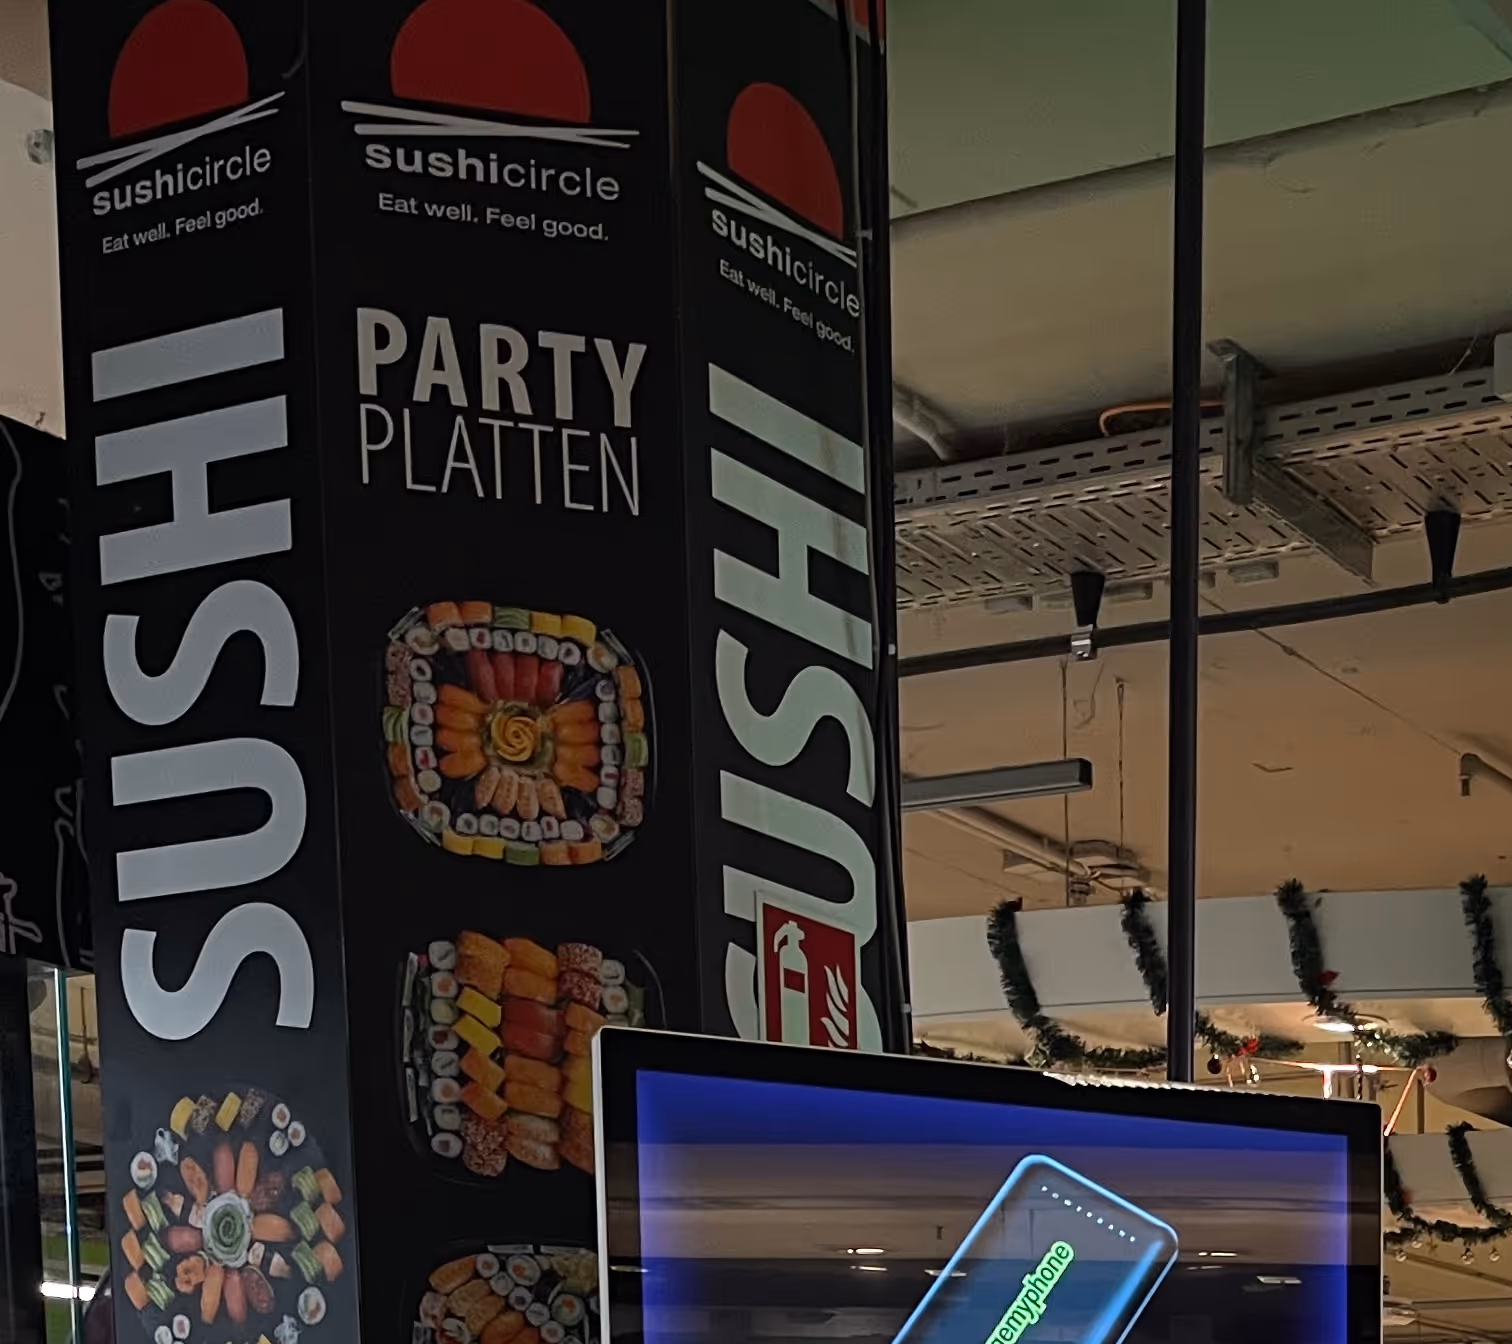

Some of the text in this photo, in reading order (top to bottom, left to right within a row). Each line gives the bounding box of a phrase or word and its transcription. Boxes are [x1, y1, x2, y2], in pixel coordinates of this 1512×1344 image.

[92, 145, 272, 216] sushicircle
[364, 143, 621, 202] sushicircle
[378, 193, 609, 243] Eat well. Feel good.
[101, 199, 264, 256] Eat well. Feel good.
[710, 208, 861, 319] sushicircle
[719, 258, 856, 356] Eat well. Feel good.
[356, 306, 648, 430] PARTY
[359, 402, 640, 518] PLATTEN
[92, 308, 314, 1041] SUSHI
